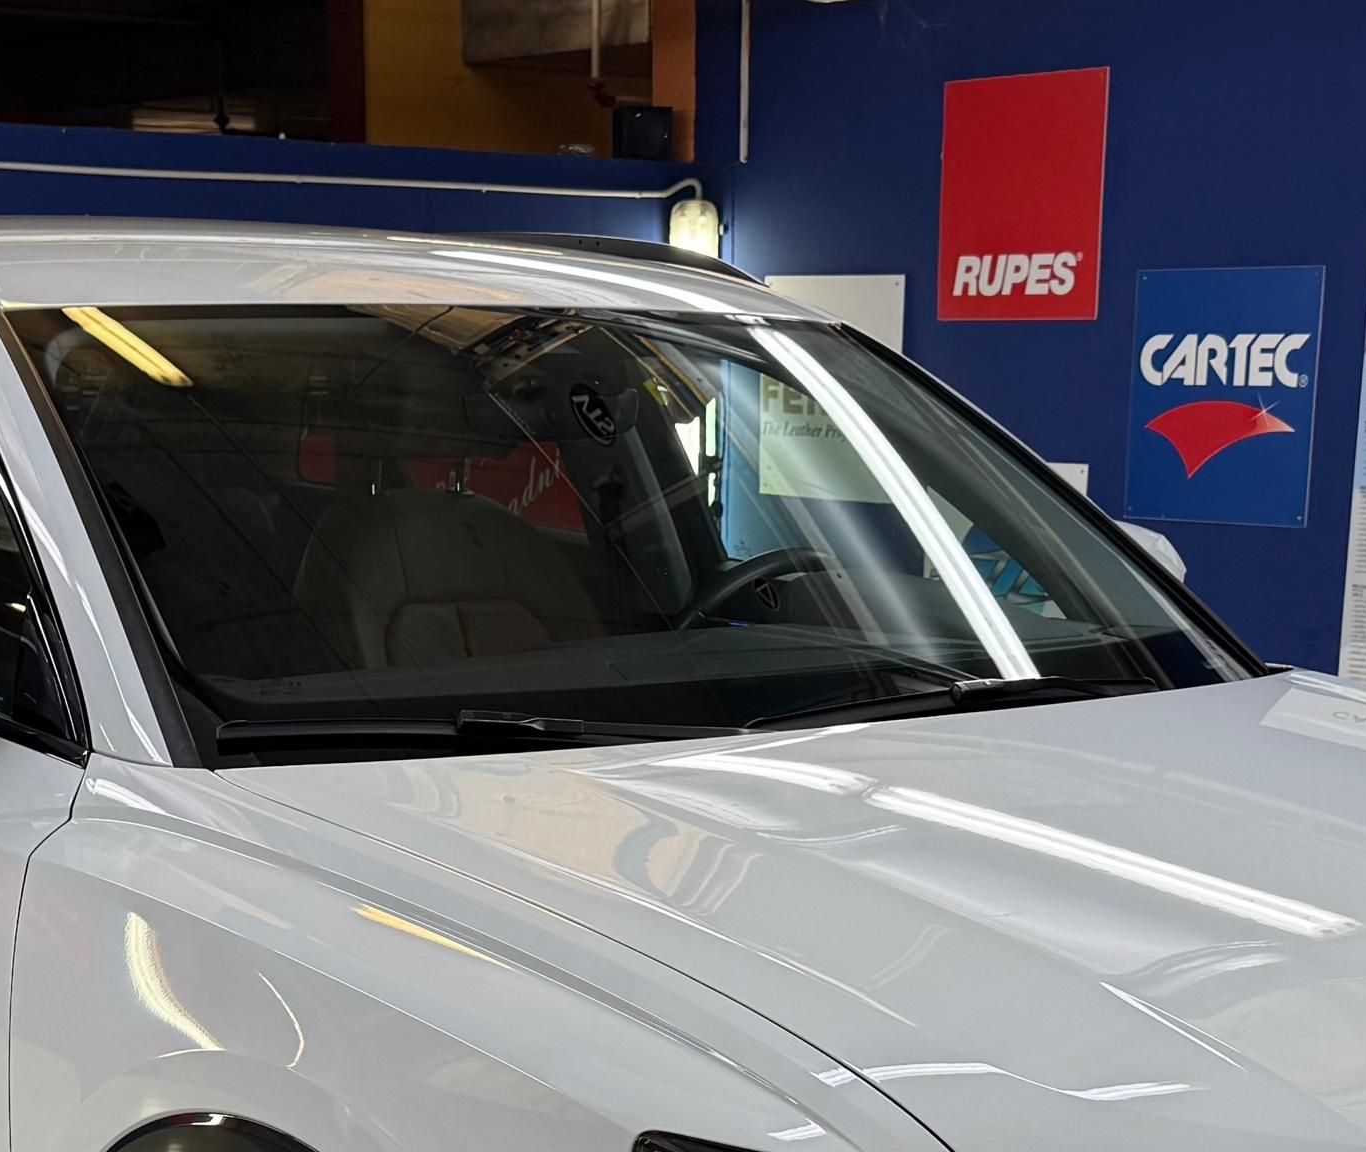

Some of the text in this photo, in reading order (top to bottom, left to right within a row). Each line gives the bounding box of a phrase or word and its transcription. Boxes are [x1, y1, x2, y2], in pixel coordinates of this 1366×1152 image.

[952, 251, 1077, 296] RUPES
[1140, 333, 1311, 388] CARTEC
[782, 421, 822, 438] Leather
